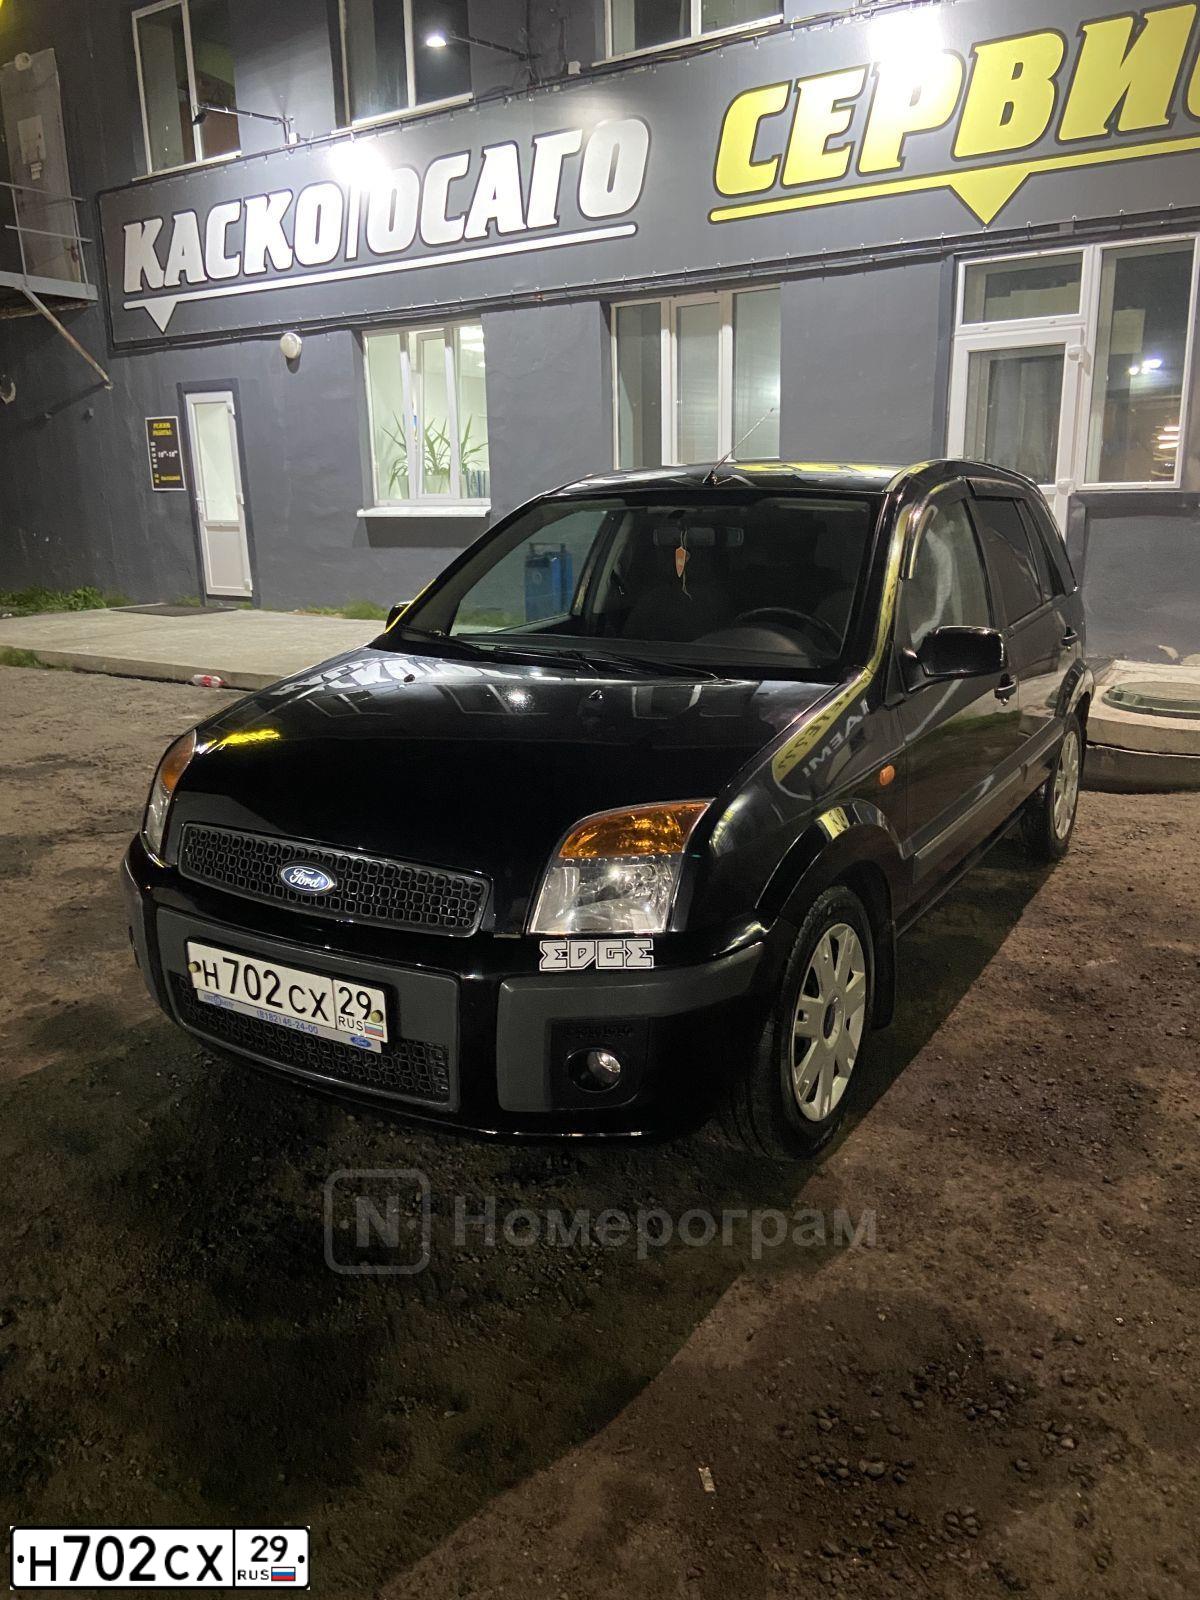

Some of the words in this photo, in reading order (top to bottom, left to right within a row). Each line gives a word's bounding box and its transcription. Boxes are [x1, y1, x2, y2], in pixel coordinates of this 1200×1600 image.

[713, 2, 1200, 198] СЕРВИ
[123, 180, 345, 293] КАСКО
[365, 114, 652, 256] ОСАГО
[289, 868, 322, 888] Ford
[539, 938, 655, 971] EDGE
[338, 986, 372, 1020] 29
[338, 1016, 364, 1031] RUS
